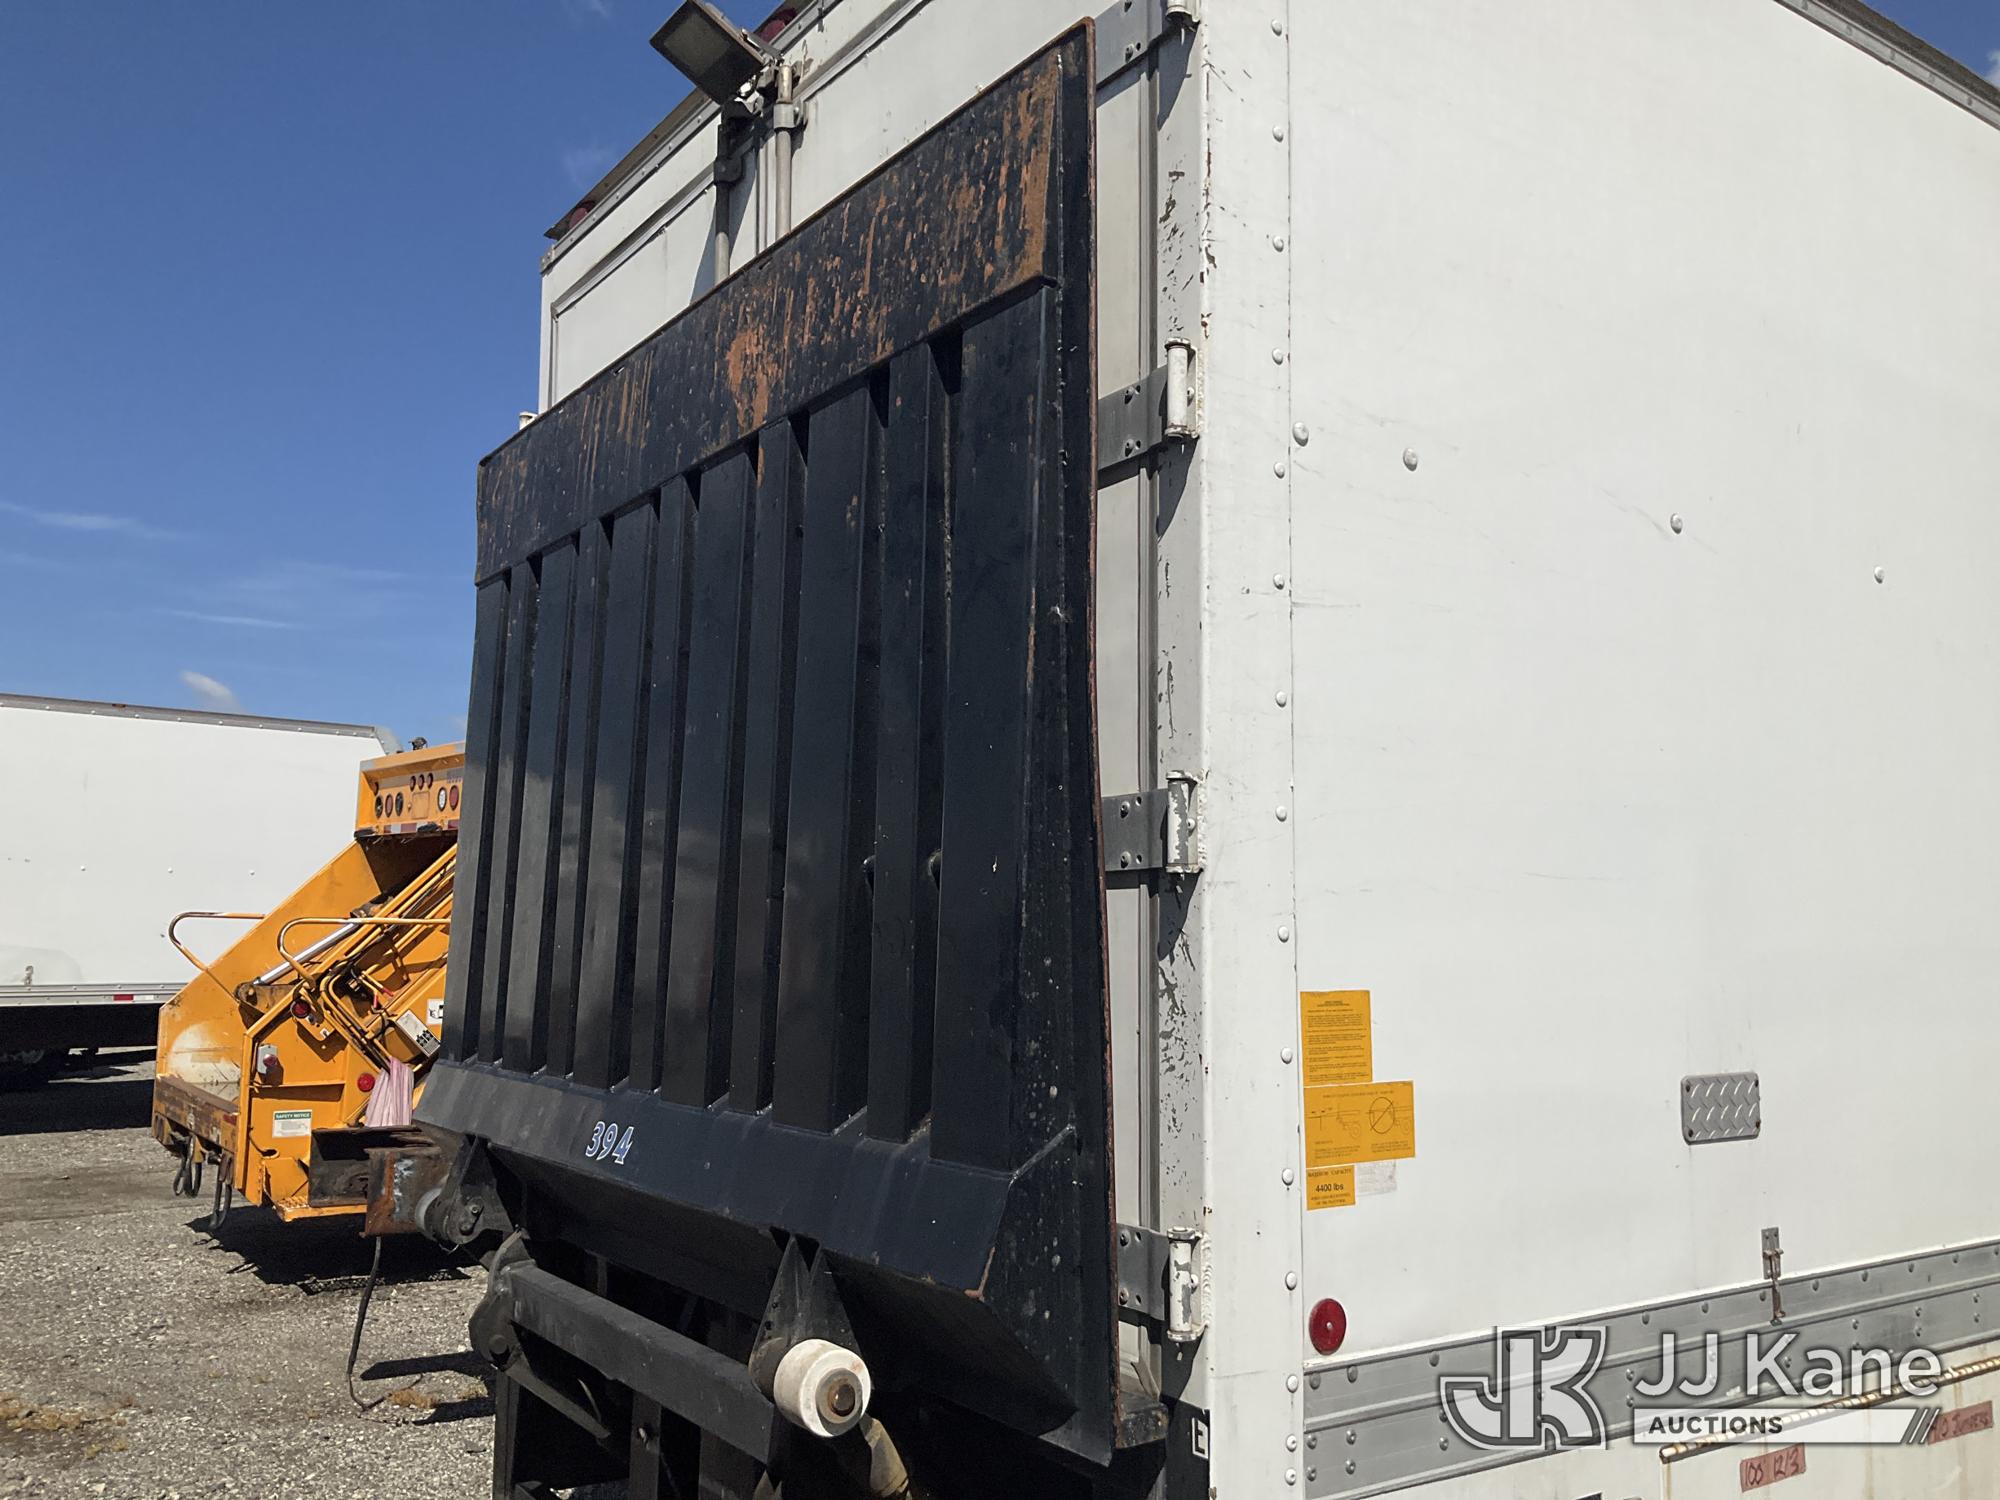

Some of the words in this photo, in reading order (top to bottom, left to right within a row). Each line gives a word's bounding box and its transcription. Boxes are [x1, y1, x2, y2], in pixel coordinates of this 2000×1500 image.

[585, 1121, 635, 1165] 394
[1315, 1183, 1332, 1192] 4400
[1333, 1183, 1344, 1191] lbs
